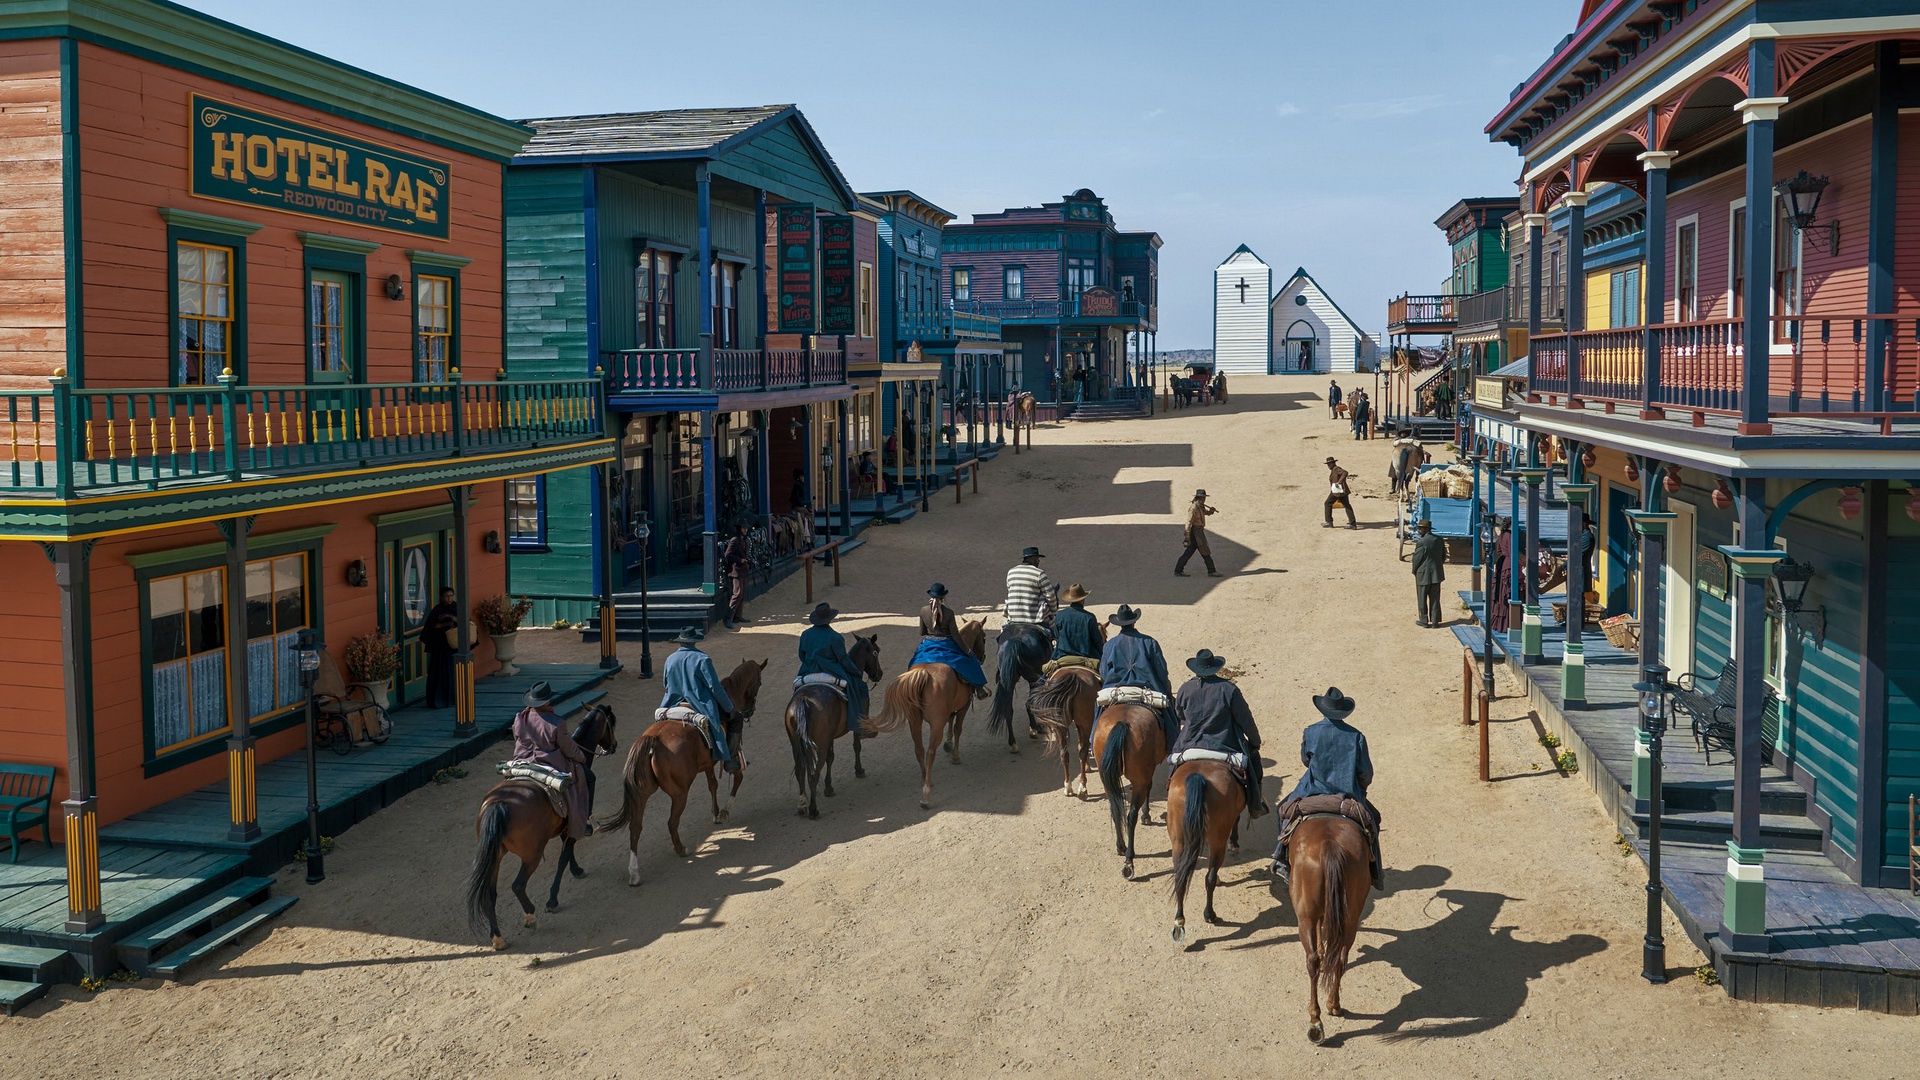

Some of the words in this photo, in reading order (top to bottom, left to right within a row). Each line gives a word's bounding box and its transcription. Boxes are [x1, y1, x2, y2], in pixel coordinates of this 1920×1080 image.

[211, 132, 360, 199] HOTEL
[365, 158, 438, 223] RAE
[283, 189, 354, 215] REDWOOD
[357, 204, 388, 222] CITY
